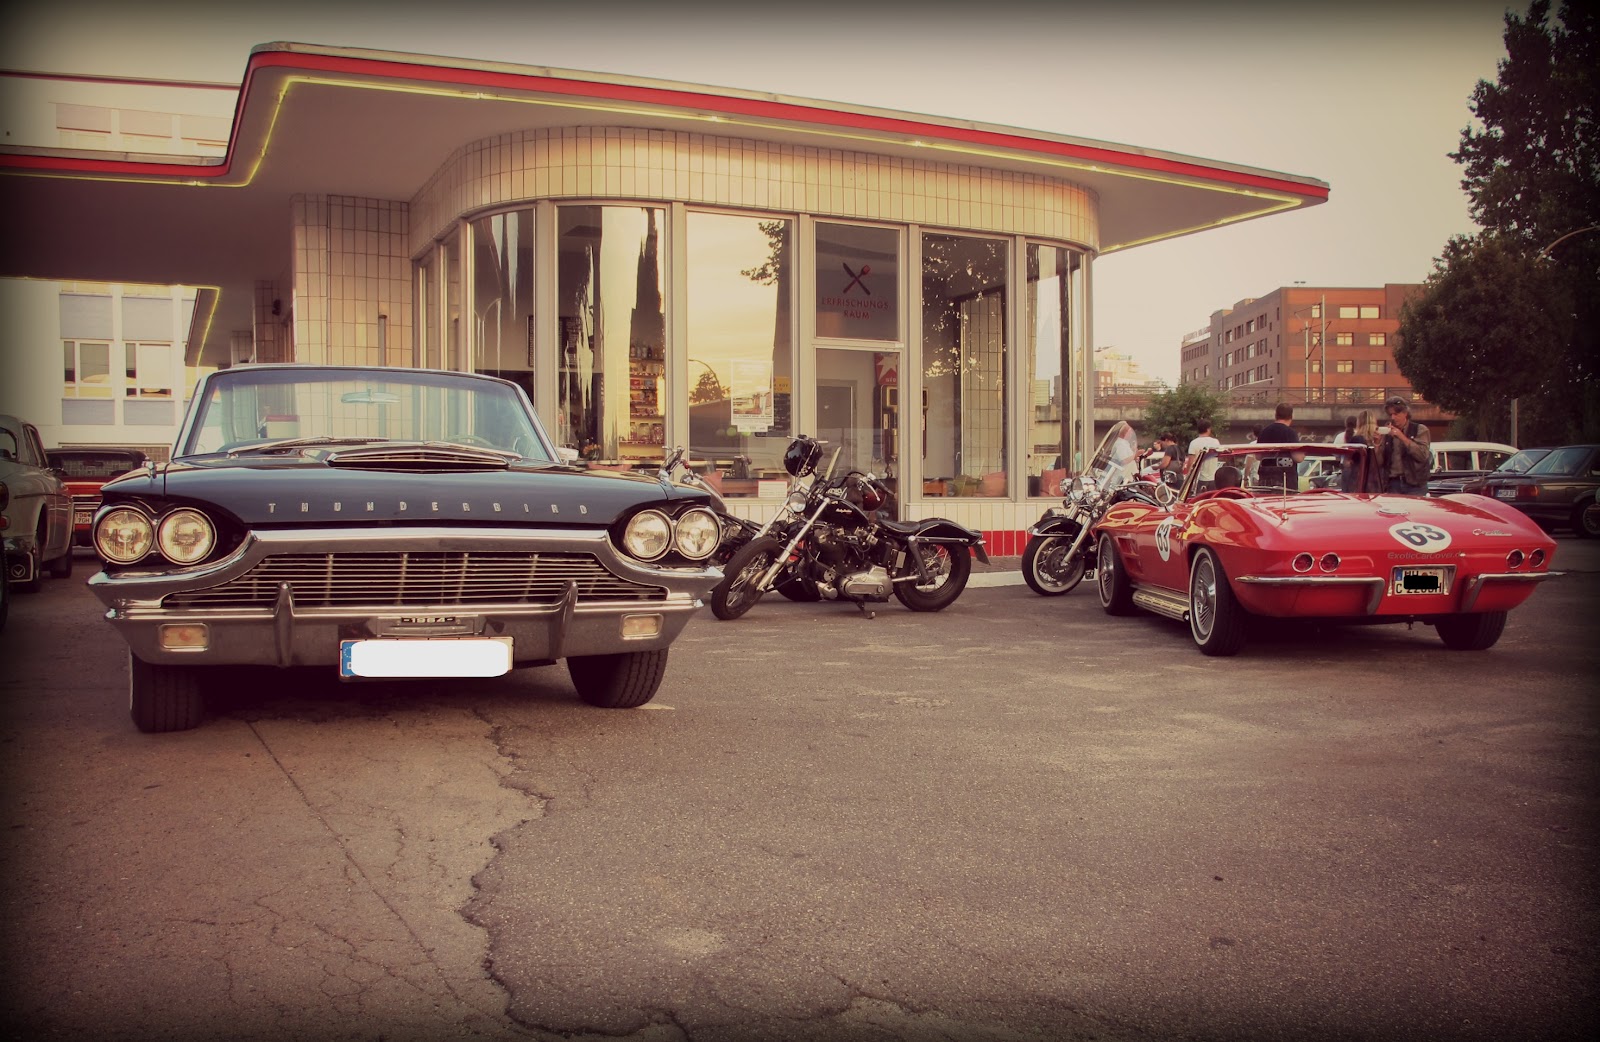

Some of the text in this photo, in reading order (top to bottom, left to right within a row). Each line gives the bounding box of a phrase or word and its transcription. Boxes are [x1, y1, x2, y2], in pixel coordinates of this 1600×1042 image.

[822, 297, 889, 309] ERFRISCHUNGS
[844, 310, 869, 319] RAUM
[268, 502, 588, 514] THUNDERBIRD
[1157, 524, 1170, 552] 63
[1395, 525, 1446, 546] 63
[1387, 550, 1465, 560] ExoticCarCover.d
